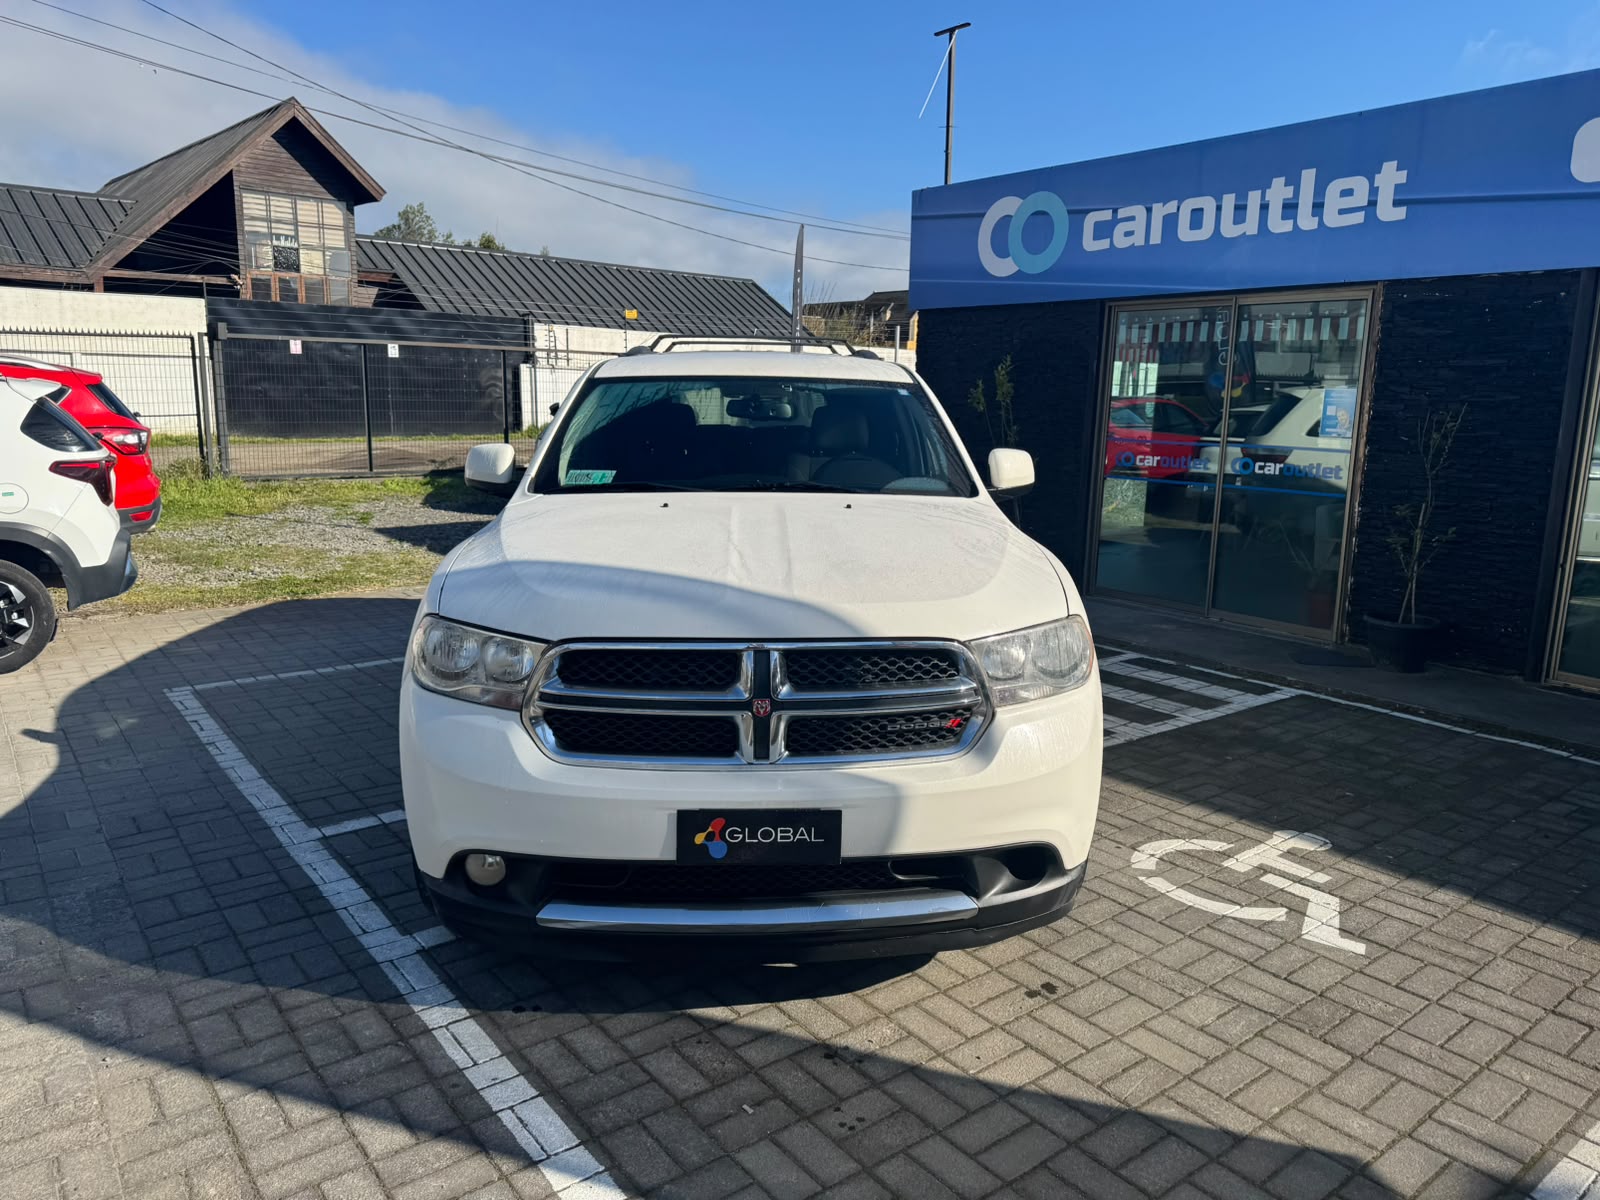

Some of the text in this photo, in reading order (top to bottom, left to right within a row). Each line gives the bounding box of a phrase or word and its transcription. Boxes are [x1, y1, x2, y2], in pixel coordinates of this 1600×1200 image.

[1082, 160, 1408, 251] caroutlet
[1135, 454, 1211, 471] caroutlet
[1254, 461, 1343, 480] caroutlet
[725, 827, 825, 843] GLOBAL
